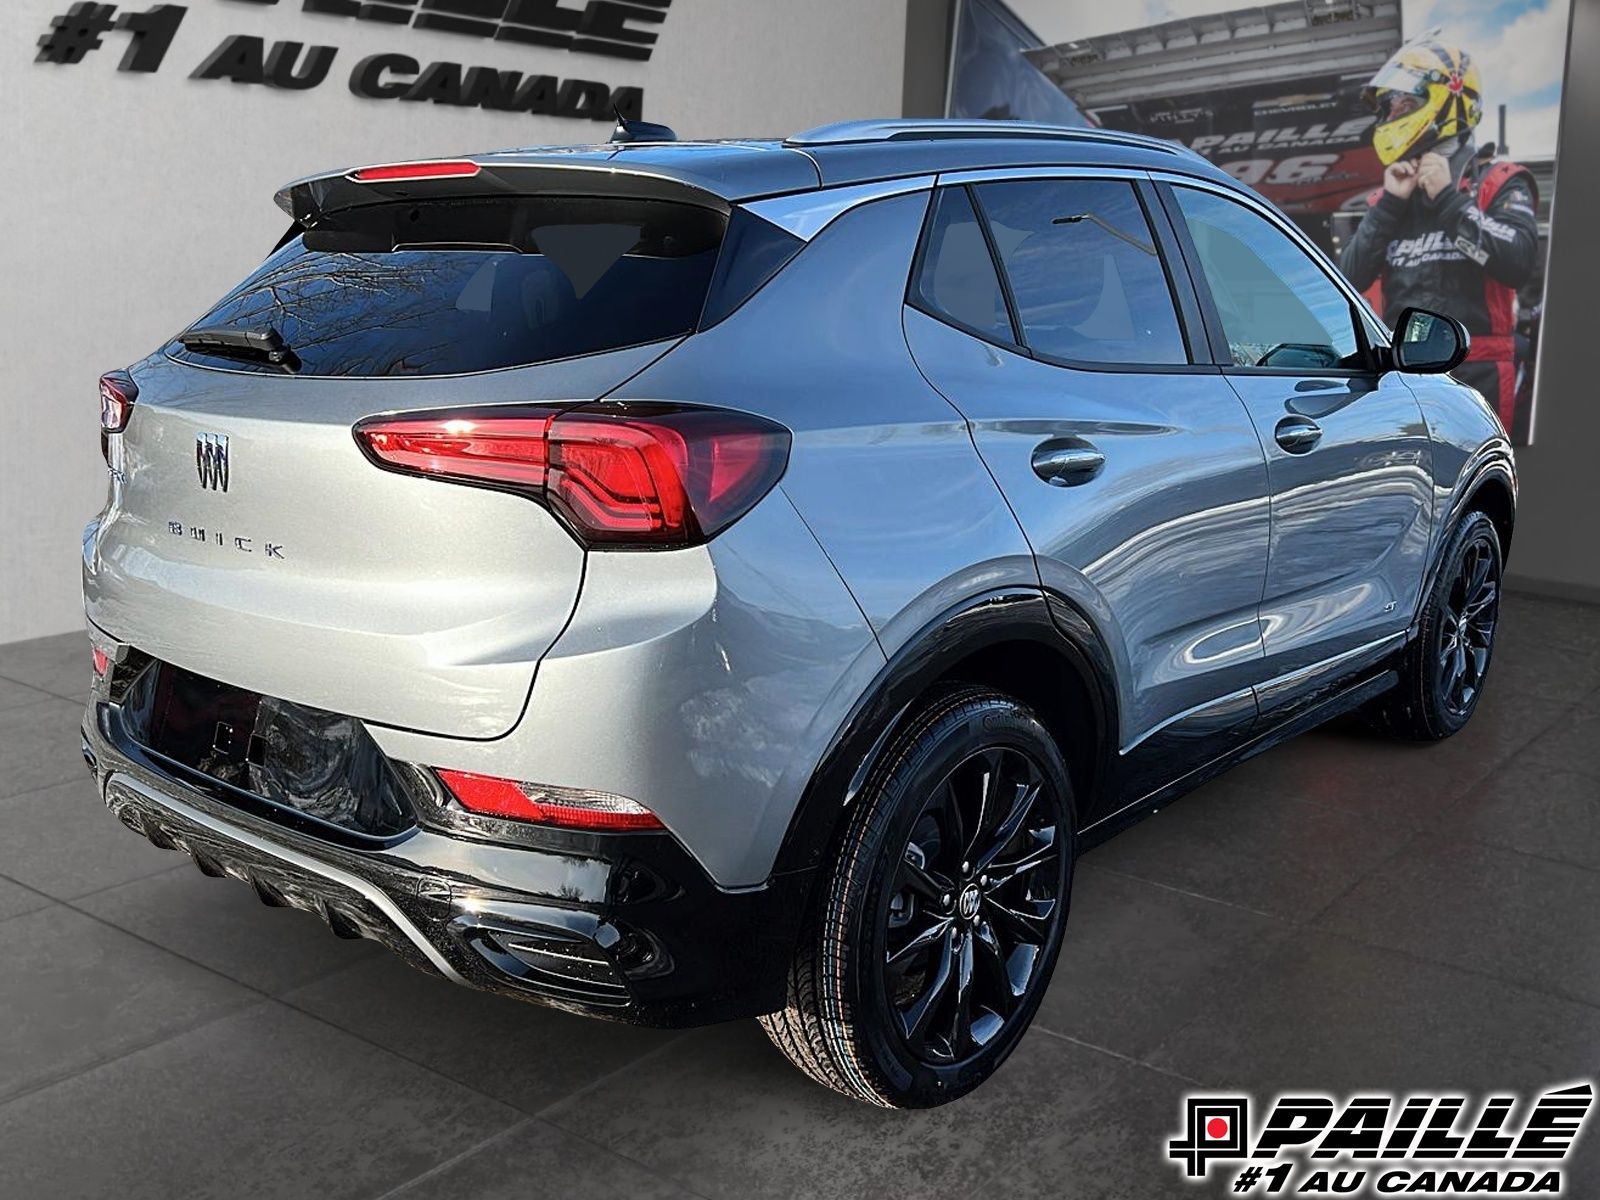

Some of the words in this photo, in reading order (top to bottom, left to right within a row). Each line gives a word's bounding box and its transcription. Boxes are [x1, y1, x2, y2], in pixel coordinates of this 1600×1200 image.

[34, 1, 188, 73] #1
[188, 35, 339, 91] AU
[348, 53, 645, 122] CANADA
[1217, 145, 1250, 154] AU
[1258, 136, 1361, 150] CANADA
[1219, 153, 1340, 185] 96
[168, 521, 285, 560] BUICK
